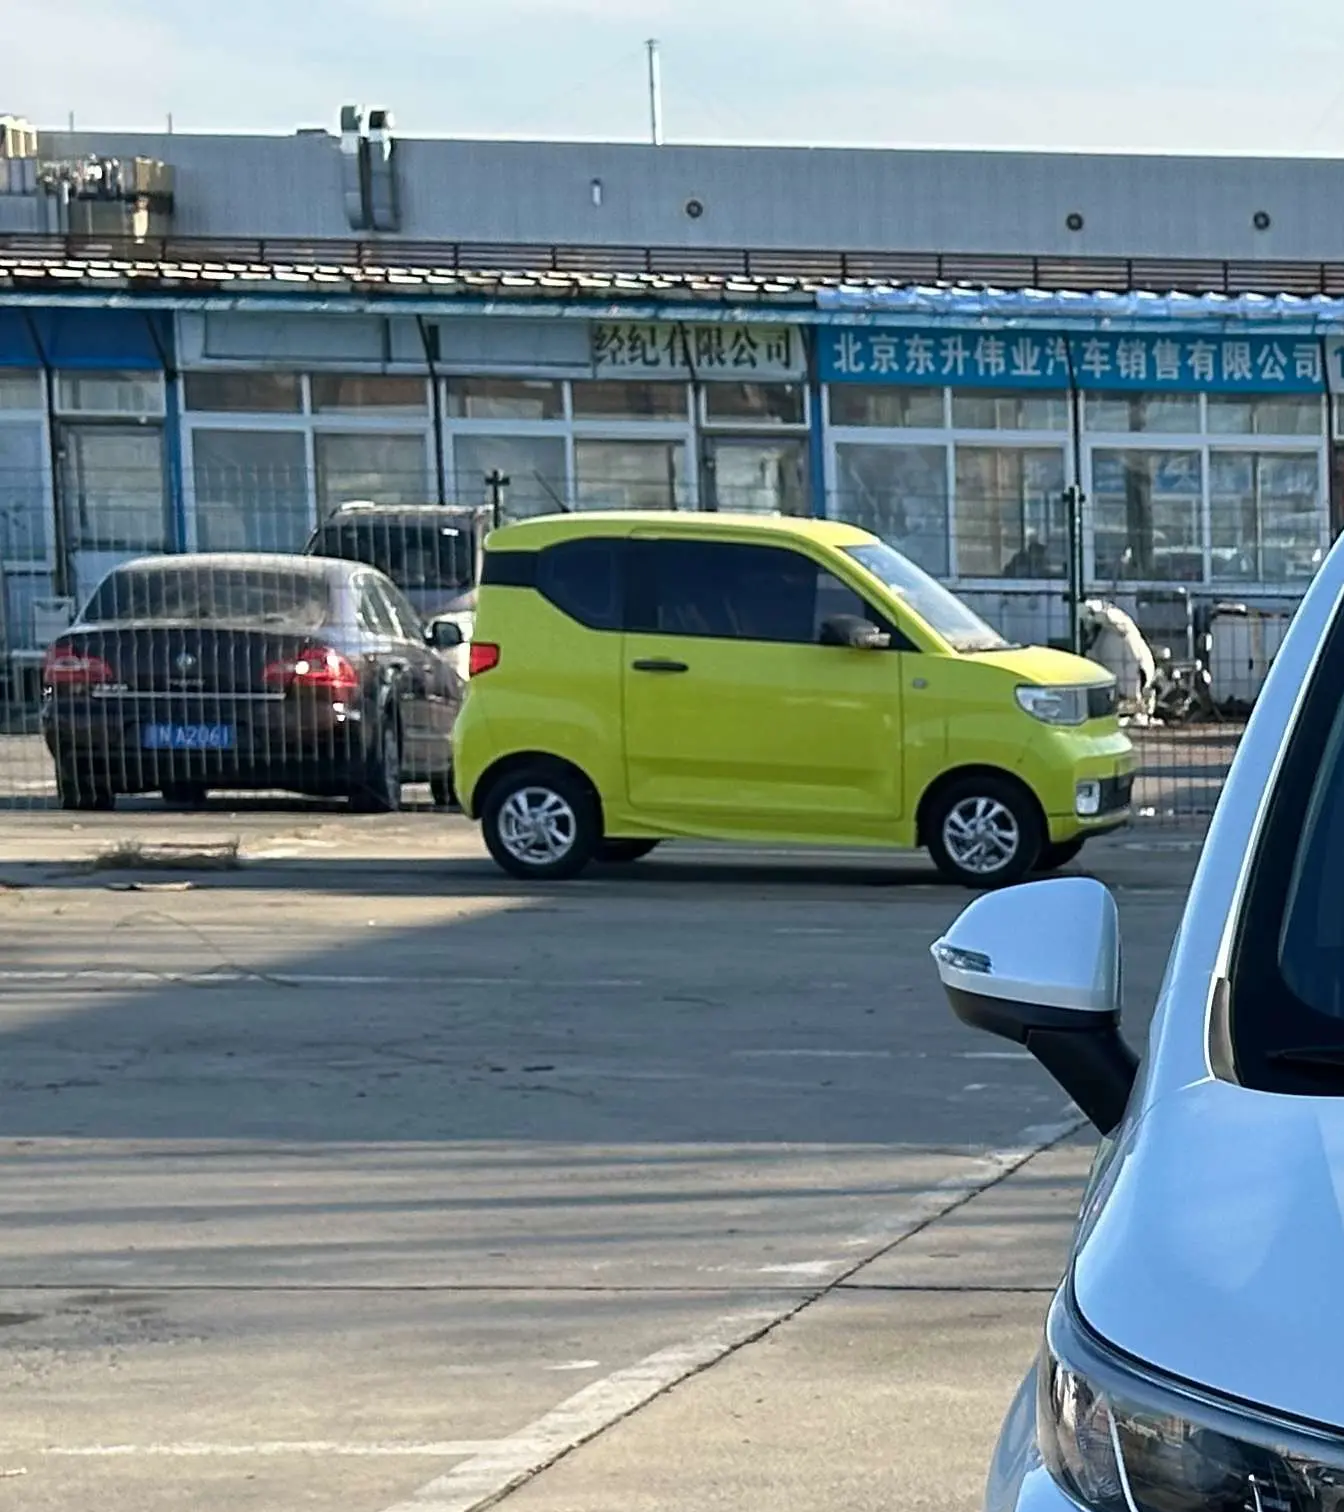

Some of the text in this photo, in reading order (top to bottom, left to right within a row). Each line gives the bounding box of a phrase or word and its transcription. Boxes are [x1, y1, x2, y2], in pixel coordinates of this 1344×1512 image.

[833, 332, 1323, 383] 北京东升伟业汽车销售有限公司
